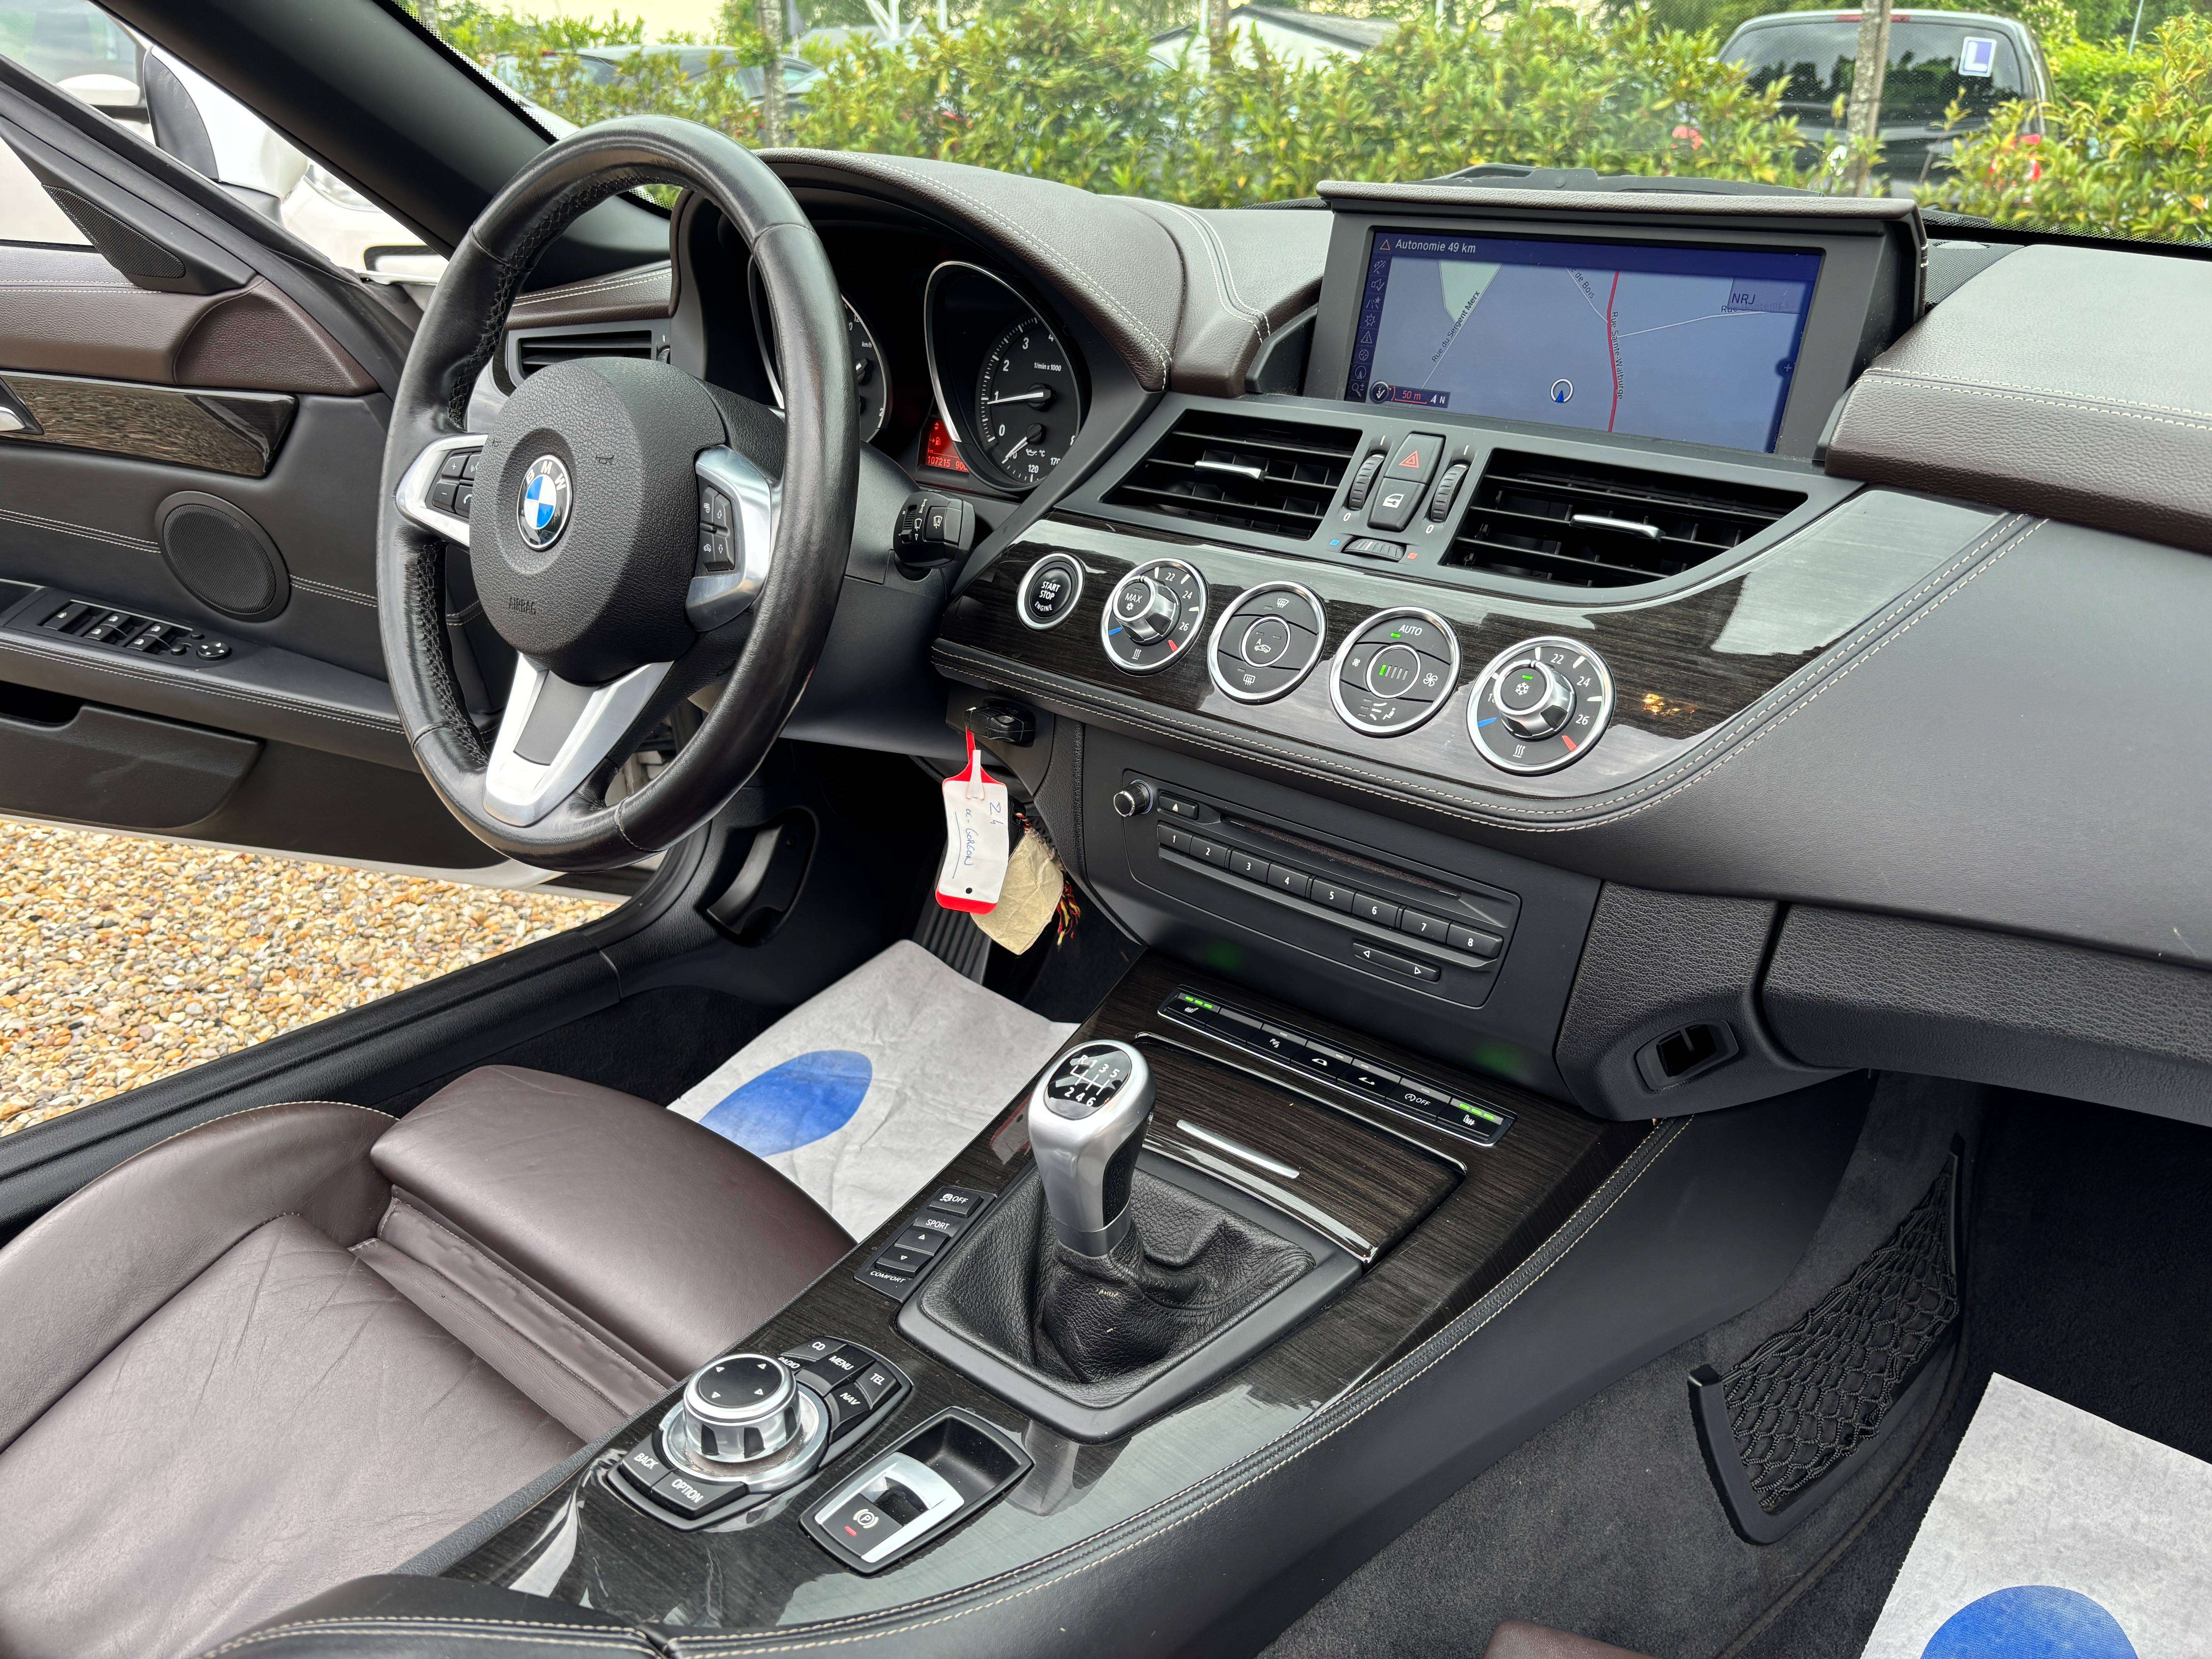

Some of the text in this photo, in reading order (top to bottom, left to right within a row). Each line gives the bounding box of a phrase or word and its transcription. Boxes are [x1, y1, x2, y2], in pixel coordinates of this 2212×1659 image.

[1395, 239, 1476, 253] Autonomie 49 km
[1575, 272, 1595, 299] de Bois
[1731, 293, 1755, 305] NRJ
[1431, 291, 1480, 362] Rue du Sergent Merx
[1022, 337, 1029, 349] 3
[1003, 360, 1010, 371] 2
[1612, 330, 1624, 400] Sainte-Walburge
[994, 391, 999, 402] 1
[1402, 390, 1412, 399] 50
[999, 424, 1005, 436] 0
[928, 456, 951, 467] 107215
[1028, 464, 1039, 473] 120
[526, 461, 567, 490] BMW
[1165, 572, 1175, 581] 22
[1041, 581, 1061, 592] START
[1039, 590, 1055, 600] STOP
[1125, 593, 1142, 603] MAX
[1182, 590, 1193, 599] 24
[508, 596, 536, 615] AIRBAG
[1034, 601, 1053, 612] ENGINE
[1178, 622, 1189, 631] 26
[1398, 624, 1422, 636] AUTO
[1551, 654, 1564, 664] 22
[1576, 676, 1590, 687] 24
[1575, 714, 1589, 725] 26
[1246, 862, 1251, 871] 3
[1285, 876, 1290, 885] 4
[1329, 891, 1334, 900] 5
[1372, 906, 1377, 915] 6
[1421, 923, 1427, 931] 7
[1468, 938, 1473, 947] 8
[1077, 1054, 1120, 1078] R 1 3 5
[1064, 1087, 1096, 1107] 2 4 6
[951, 1196, 969, 1204] OFF
[926, 1219, 950, 1230] SPORT
[870, 1271, 906, 1283] COMFORT
[812, 1341, 826, 1351] CD
[828, 1355, 854, 1370] MENU
[870, 1373, 885, 1385] TEL
[840, 1392, 861, 1405] NAV
[634, 1453, 659, 1470] BACK
[672, 1479, 704, 1503] OPTION
